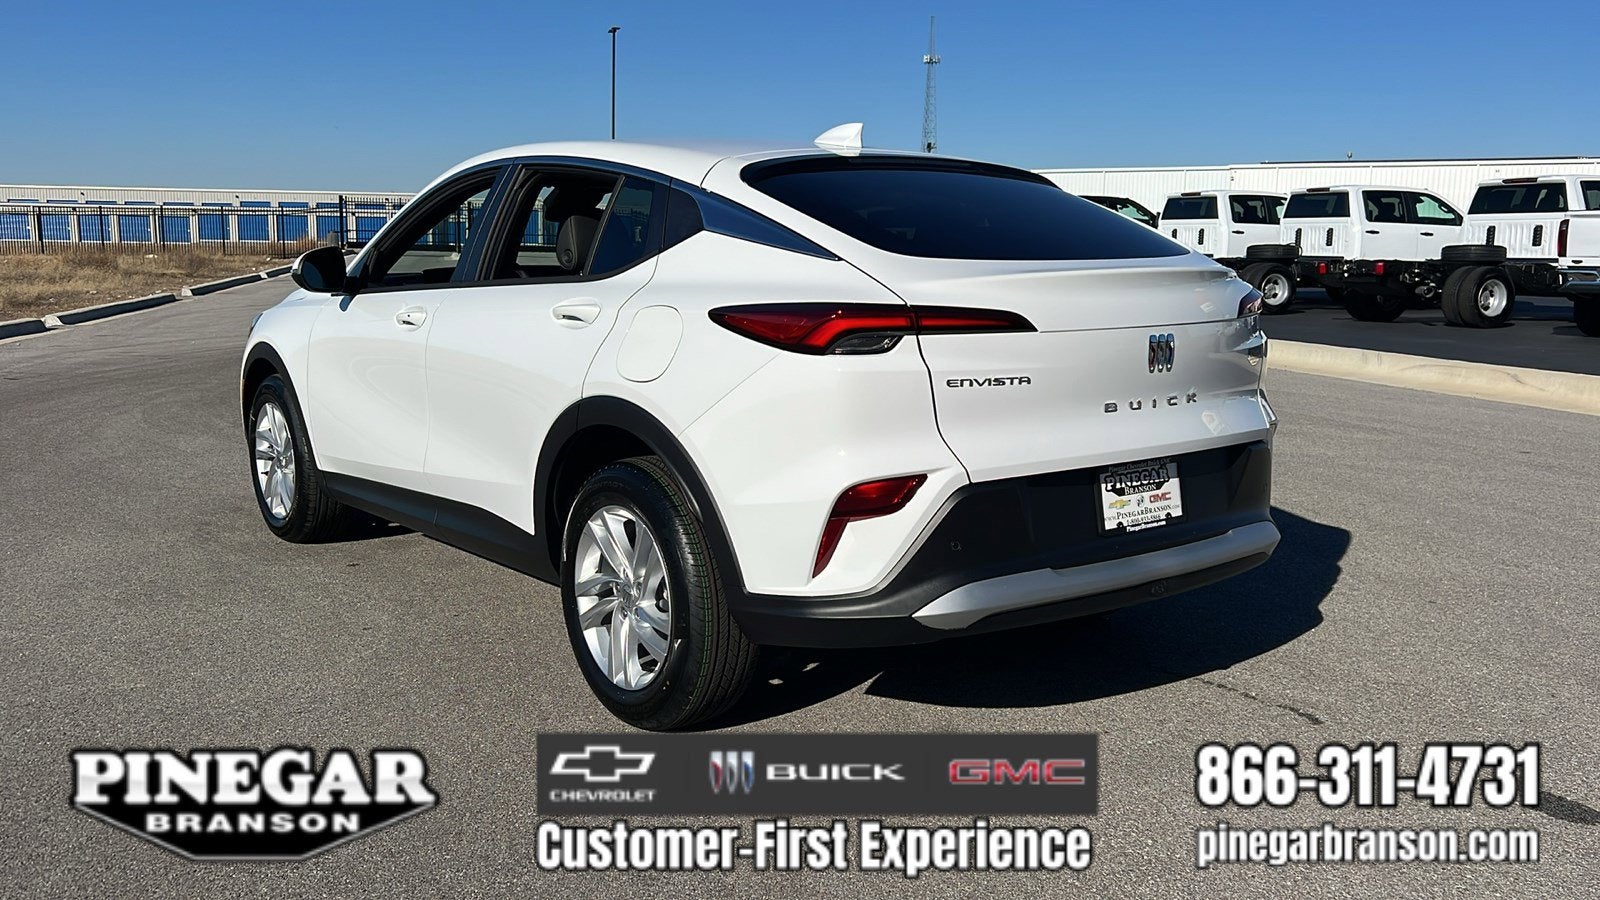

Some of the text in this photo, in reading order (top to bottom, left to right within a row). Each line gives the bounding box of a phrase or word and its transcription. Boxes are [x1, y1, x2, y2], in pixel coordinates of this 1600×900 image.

[946, 376, 1032, 388] ENVISTA
[1104, 391, 1198, 413] BUICK
[1105, 468, 1169, 491] PINEGAR
[1124, 484, 1157, 496] BRANSON
[1149, 492, 1171, 503] GMC
